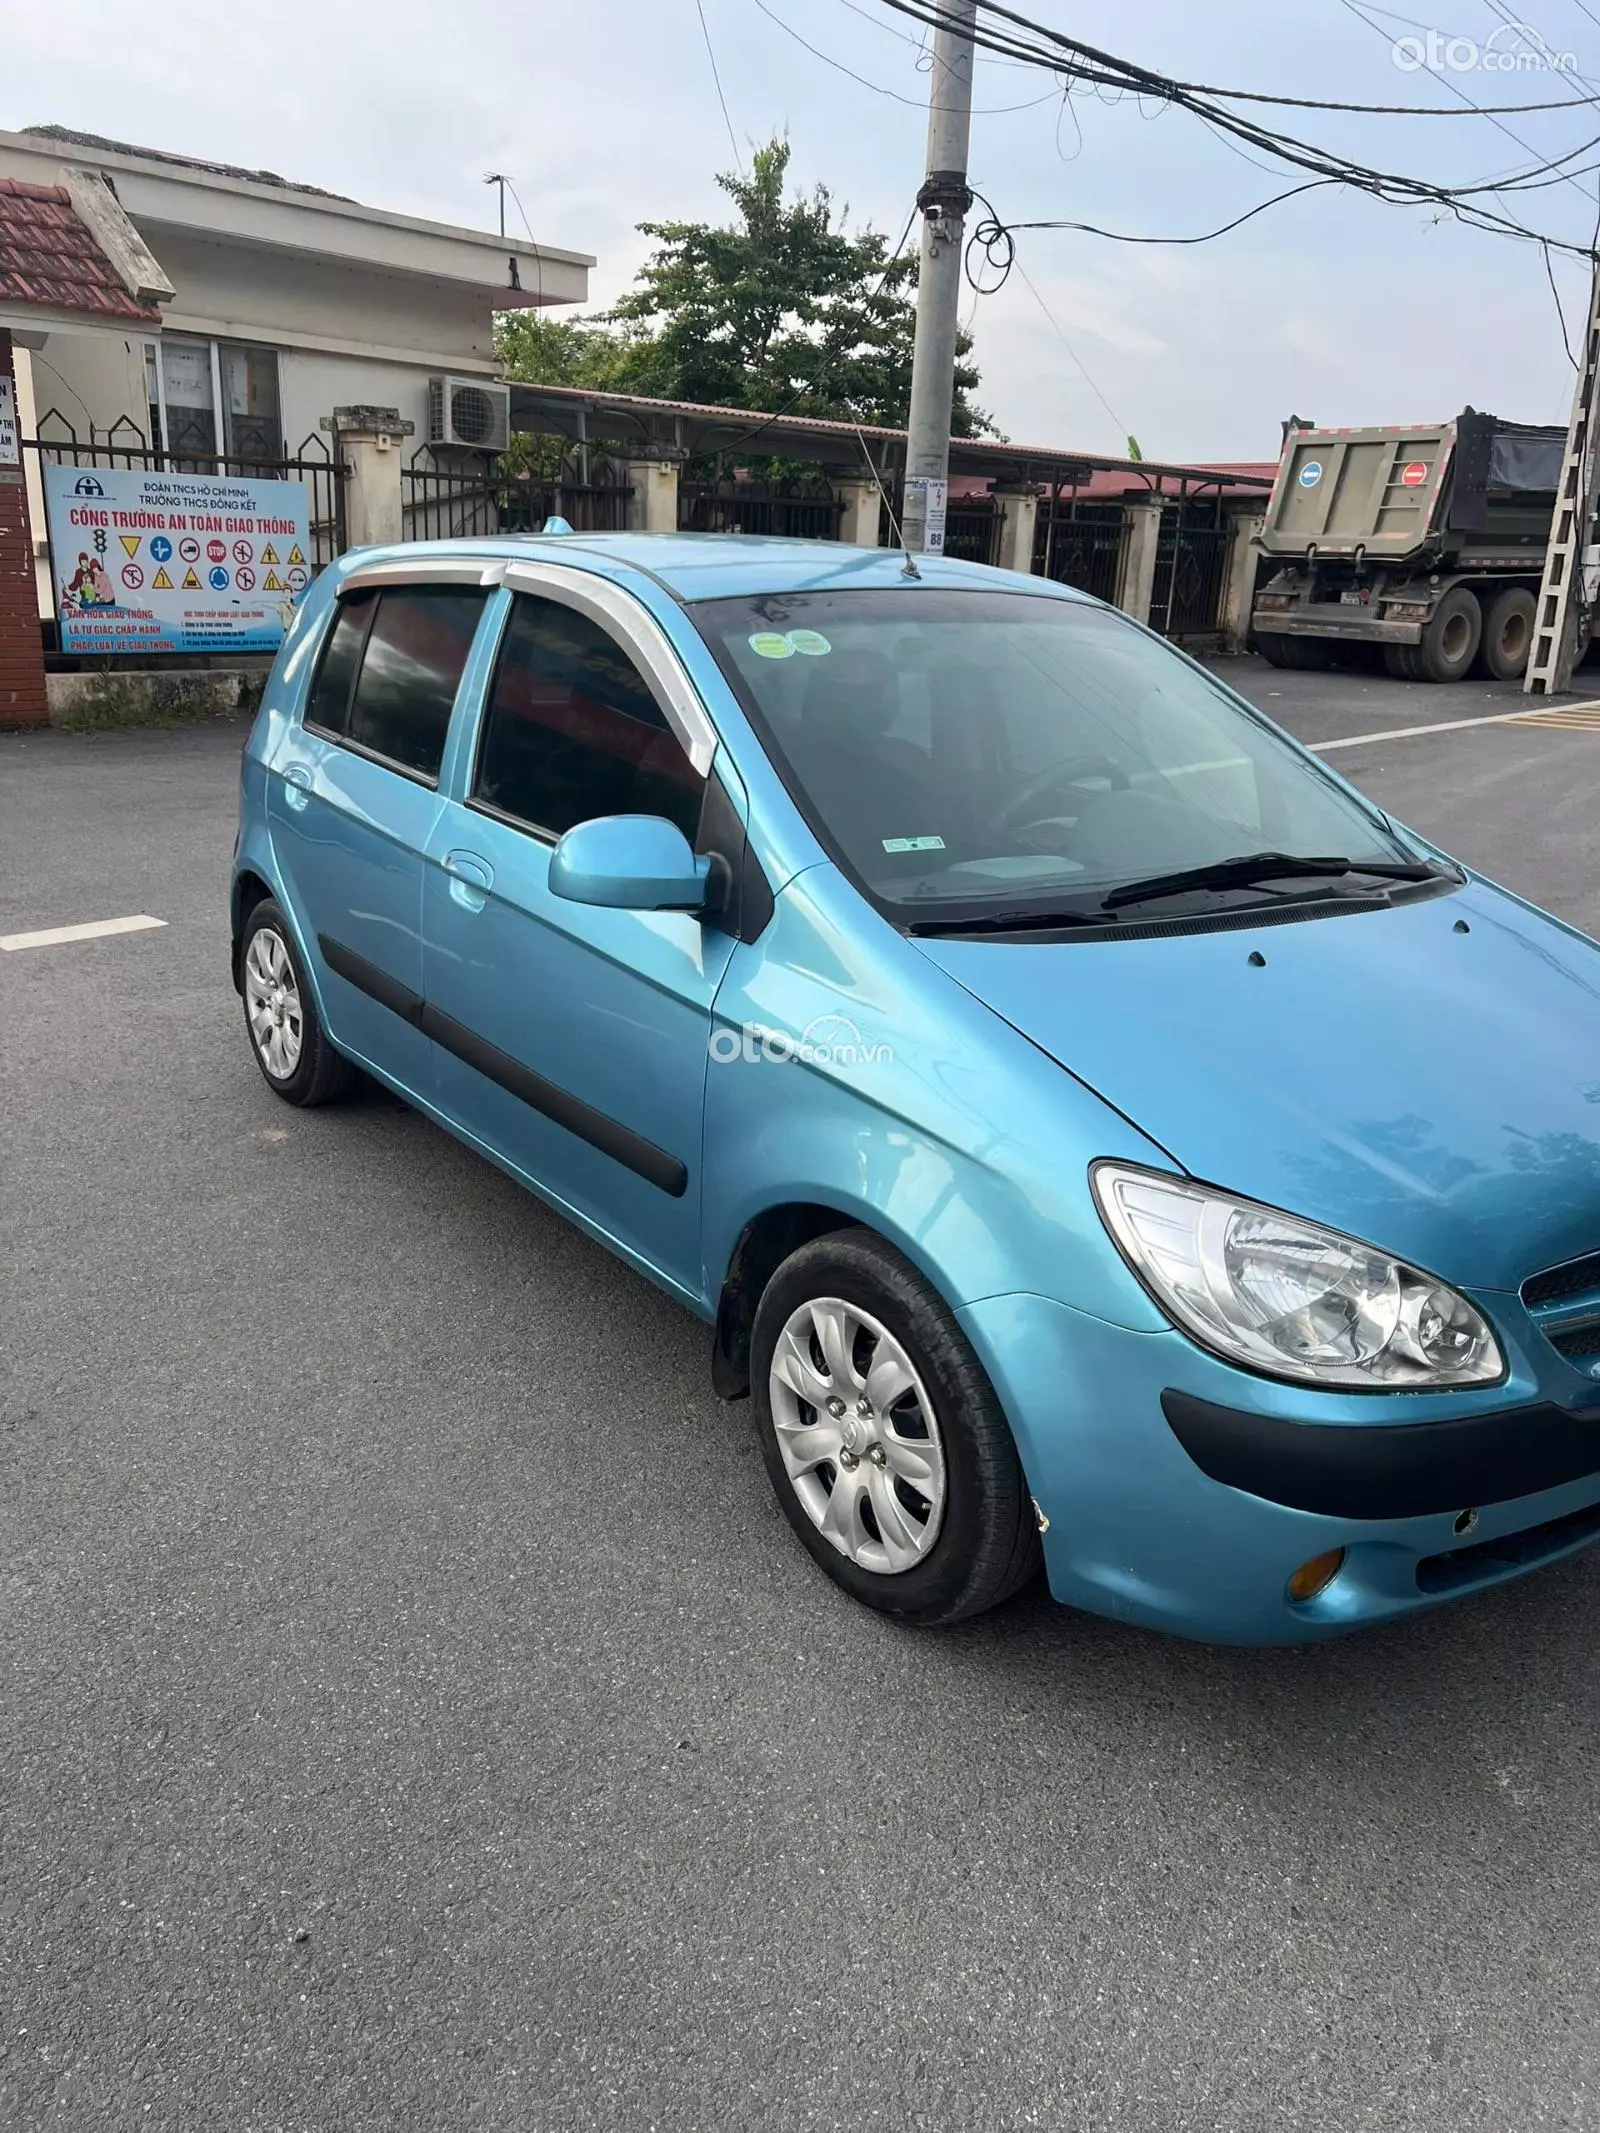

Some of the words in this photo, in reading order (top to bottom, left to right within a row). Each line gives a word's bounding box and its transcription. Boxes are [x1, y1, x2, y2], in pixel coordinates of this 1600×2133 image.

[144, 482, 170, 493] ĐOÀN
[172, 484, 196, 494] TNCS
[197, 484, 210, 496] HỒ
[212, 486, 226, 496] CHÍ
[228, 488, 249, 498] MINH
[139, 494, 180, 506] TRƯỜNG
[183, 498, 208, 508] THCS
[210, 498, 238, 510] ĐÔNG
[240, 498, 256, 510] KẾT
[70, 503, 108, 526] CỔNG
[112, 509, 165, 529] TRƯỜNG
[169, 514, 186, 530] AN
[189, 513, 222, 532] TOÀN
[226, 518, 253, 534] GIAO
[256, 516, 296, 534] THÔNG
[930, 533, 942, 546] 88
[208, 546, 225, 556] STOP
